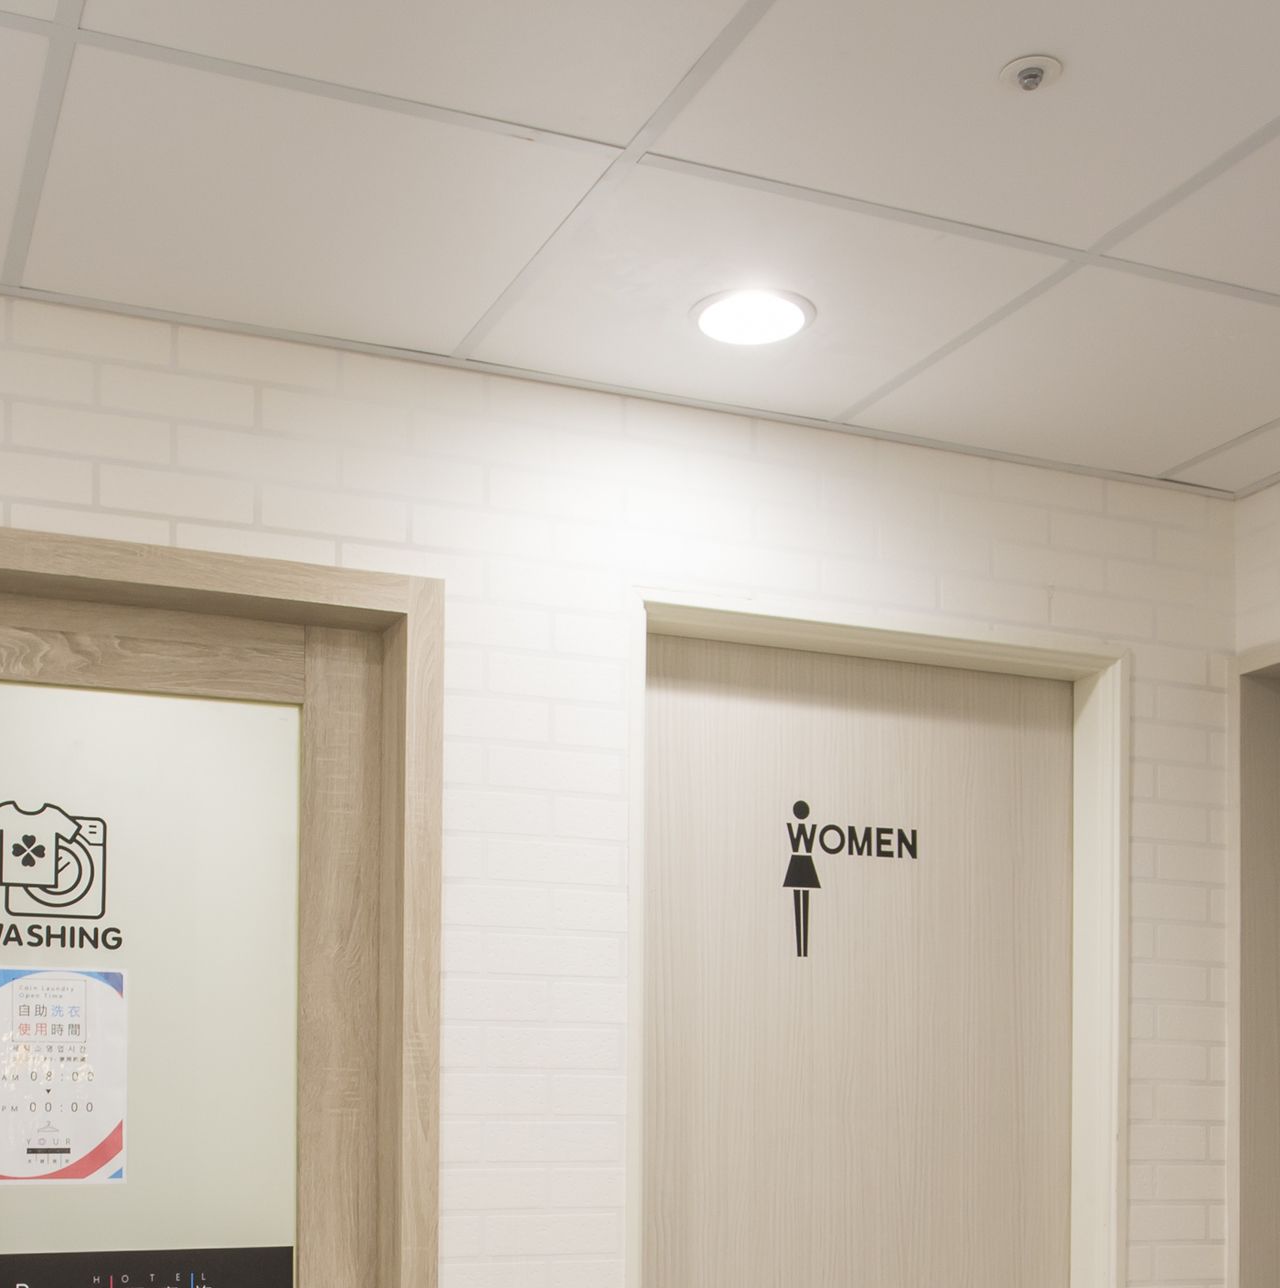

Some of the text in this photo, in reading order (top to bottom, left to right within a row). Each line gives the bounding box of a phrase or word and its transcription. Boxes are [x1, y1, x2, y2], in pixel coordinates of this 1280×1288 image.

[786, 822, 918, 859] WOMEN
[18, 1004, 81, 1018] 自助洗衣
[18, 1023, 81, 1037] 使用時間
[30, 1071, 95, 1081] 08:00
[29, 1102, 94, 1112] 00:00
[26, 1138, 71, 1146] YOUR
[92, 1272, 207, 1284] HOTEL
